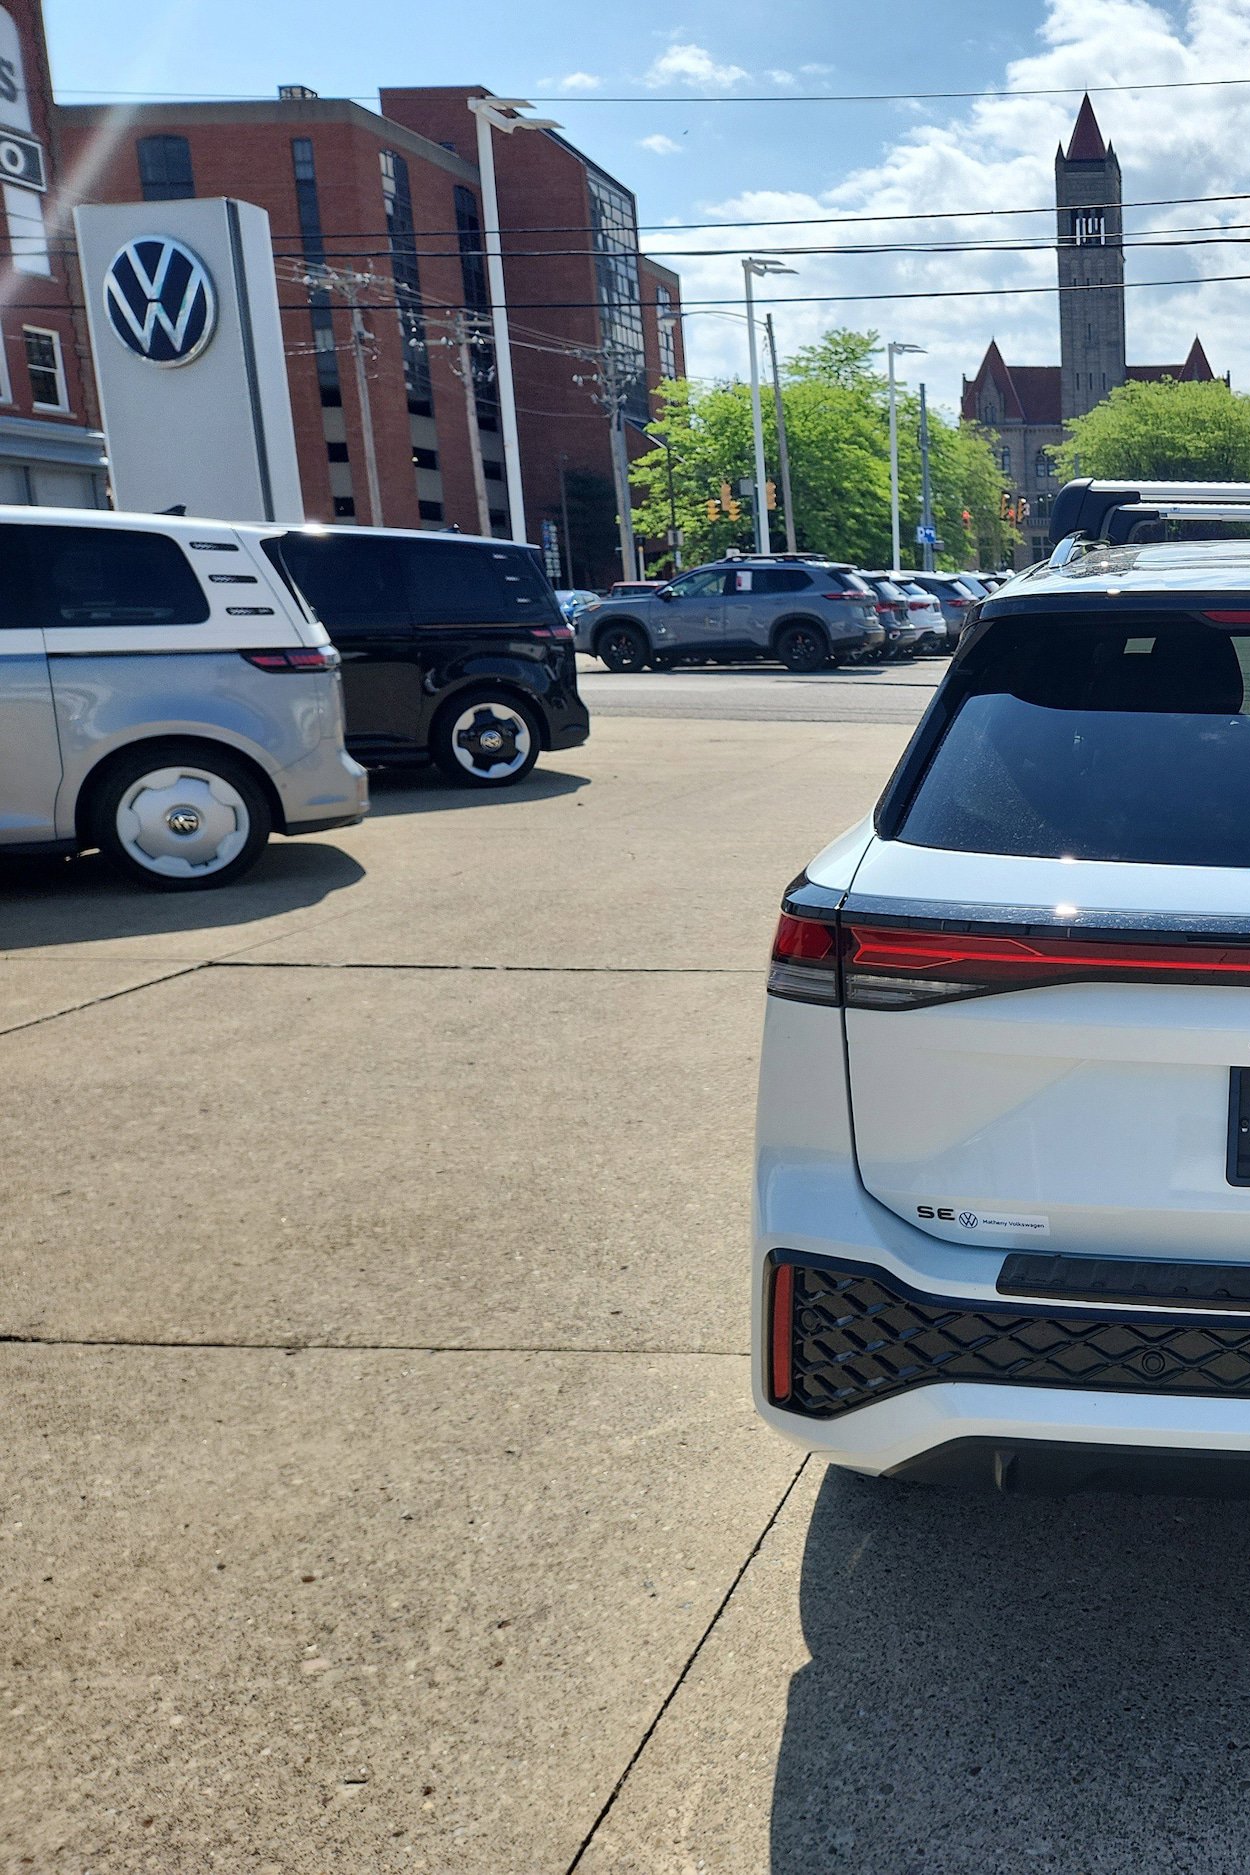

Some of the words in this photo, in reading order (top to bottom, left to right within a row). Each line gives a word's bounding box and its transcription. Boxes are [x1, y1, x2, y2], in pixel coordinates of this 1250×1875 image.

[916, 1205, 956, 1221] SE
[982, 1218, 1008, 1227] Matheny
[1008, 1221, 1045, 1229] Volkswagen
